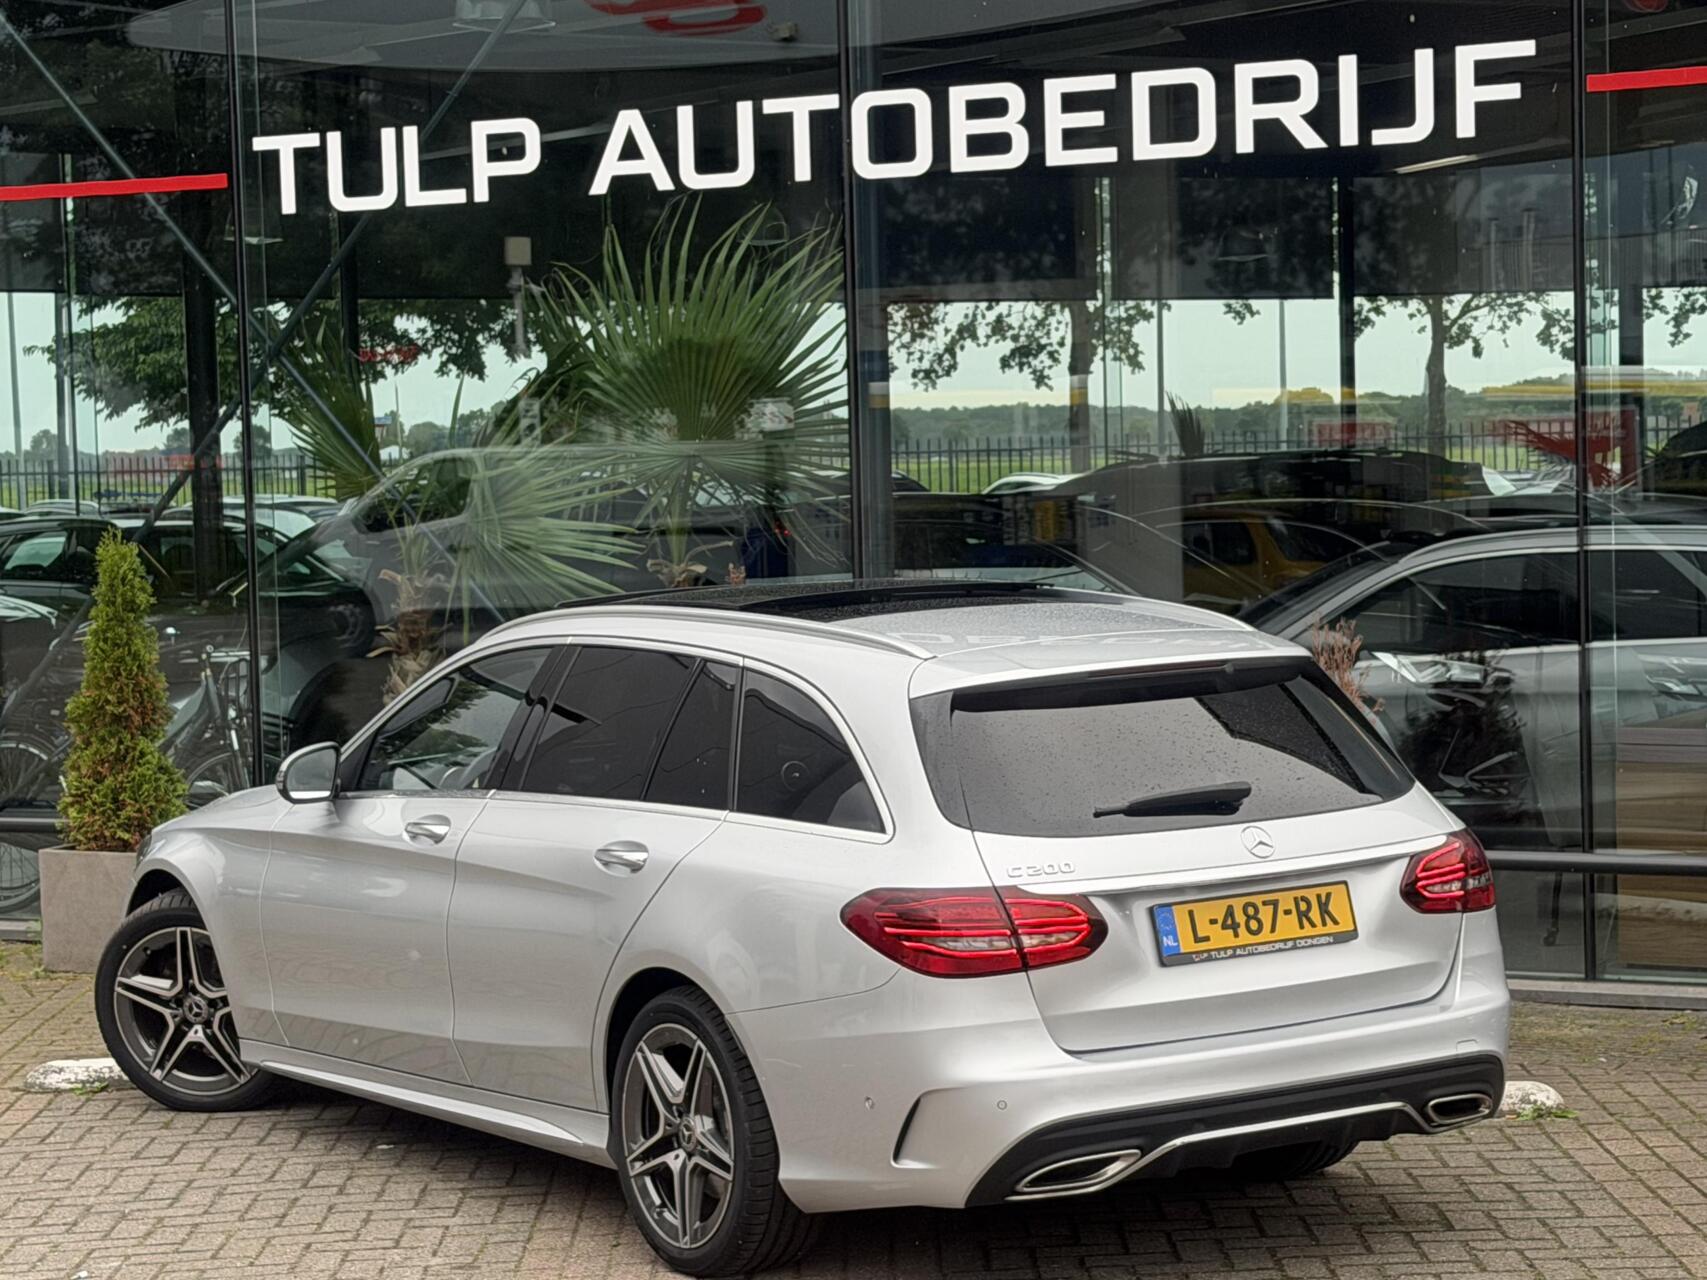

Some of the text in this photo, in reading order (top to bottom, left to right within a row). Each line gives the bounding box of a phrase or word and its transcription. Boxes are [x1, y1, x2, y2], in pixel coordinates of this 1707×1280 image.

[252, 39, 1536, 215] TULP AUTOBEDRIJF
[1187, 891, 1340, 944] L-487-RK
[1162, 936, 1178, 947] NL
[1210, 949, 1233, 959] TULP
[1235, 940, 1295, 956] AUTOBEDRIJF
[1296, 935, 1334, 948] DONGEN
